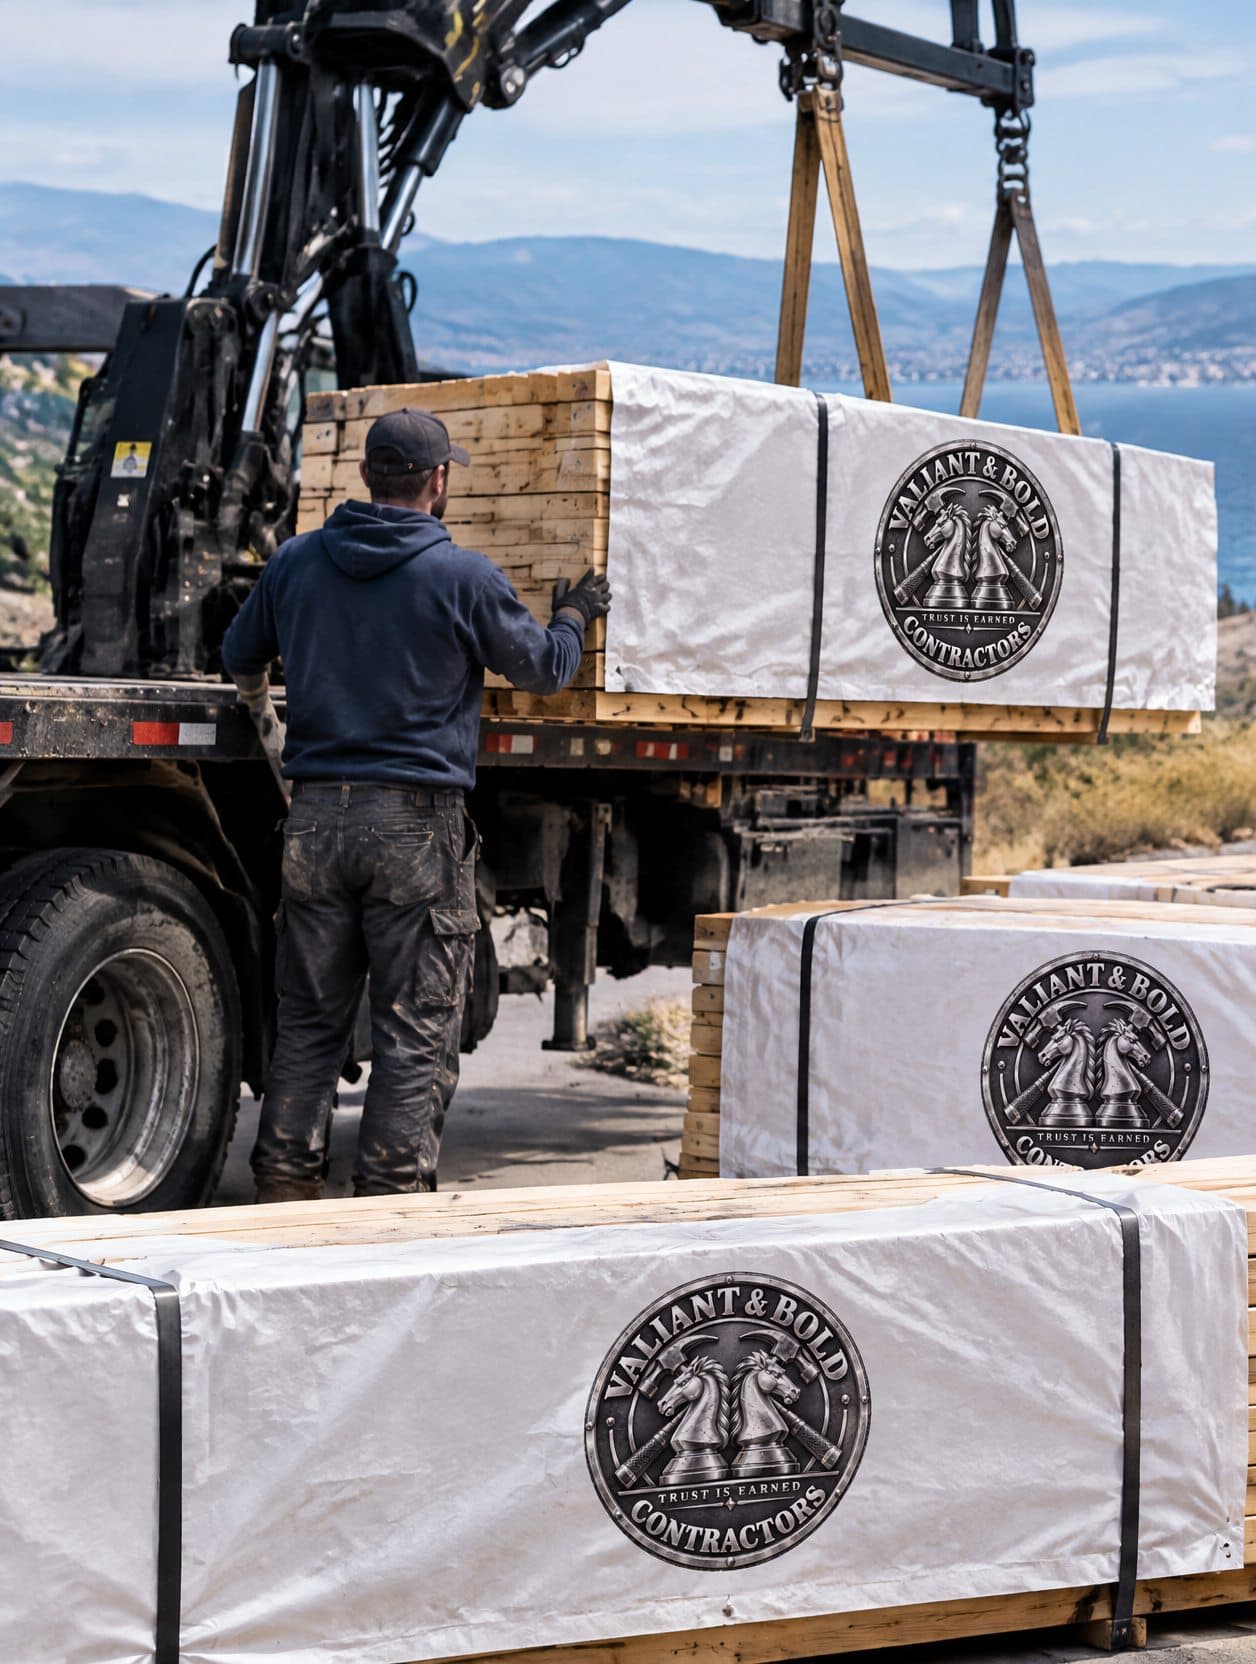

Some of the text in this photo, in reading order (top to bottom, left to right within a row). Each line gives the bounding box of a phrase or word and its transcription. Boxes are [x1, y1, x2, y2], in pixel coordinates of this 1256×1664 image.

[889, 451, 1050, 540] VALIANT & BOLD
[903, 616, 1032, 668] CONTRACTORS
[922, 613, 1015, 624] TRUST IS EARNED
[997, 963, 1190, 1050] VALIANT & BOLD
[1037, 1132, 1151, 1143] TRUST IS EARNED
[604, 1286, 849, 1400] VALIANT & BOLD
[631, 1485, 826, 1553] CONTRACTORS
[658, 1481, 800, 1503] TRUST IS EARNED
